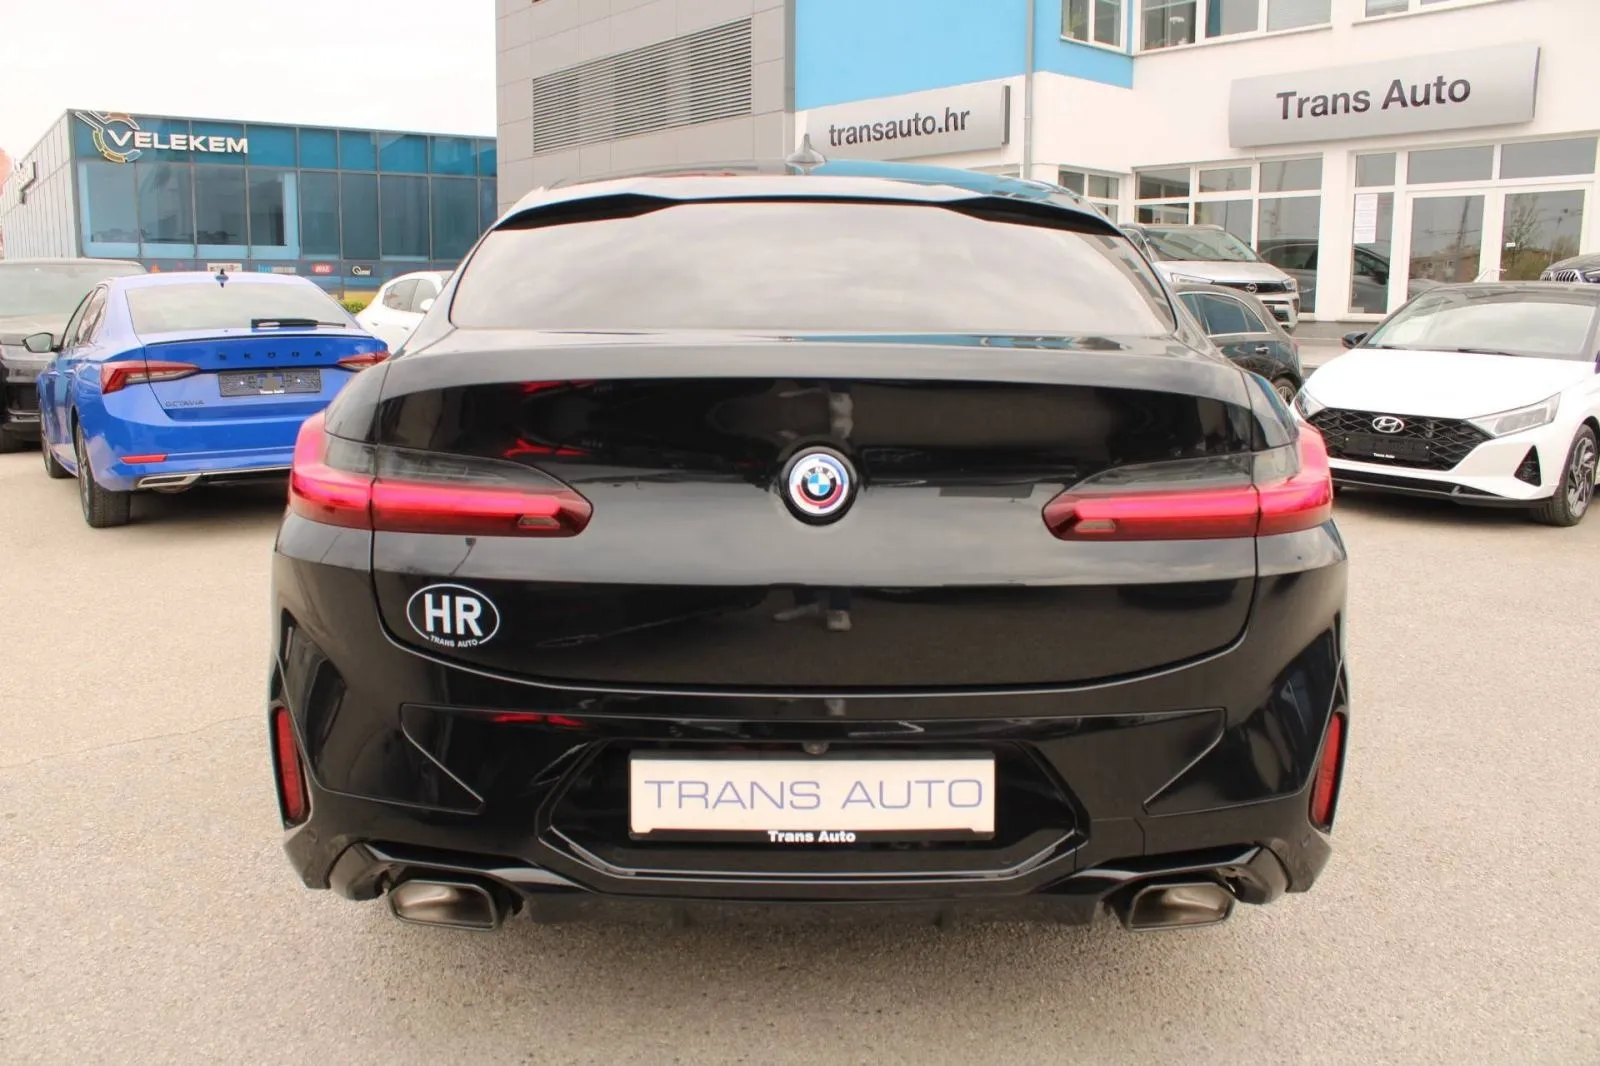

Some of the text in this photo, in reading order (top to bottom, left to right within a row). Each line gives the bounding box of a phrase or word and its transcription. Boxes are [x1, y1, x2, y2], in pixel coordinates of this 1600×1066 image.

[1276, 75, 1471, 120] Trans Auto
[107, 129, 248, 154] VELEKEM
[828, 106, 970, 147] transauto.hr
[424, 593, 483, 637] HR
[430, 635, 478, 647] TRANS AUTO
[644, 779, 983, 810] TRANS AUTO
[767, 829, 856, 843] Trans Auto
